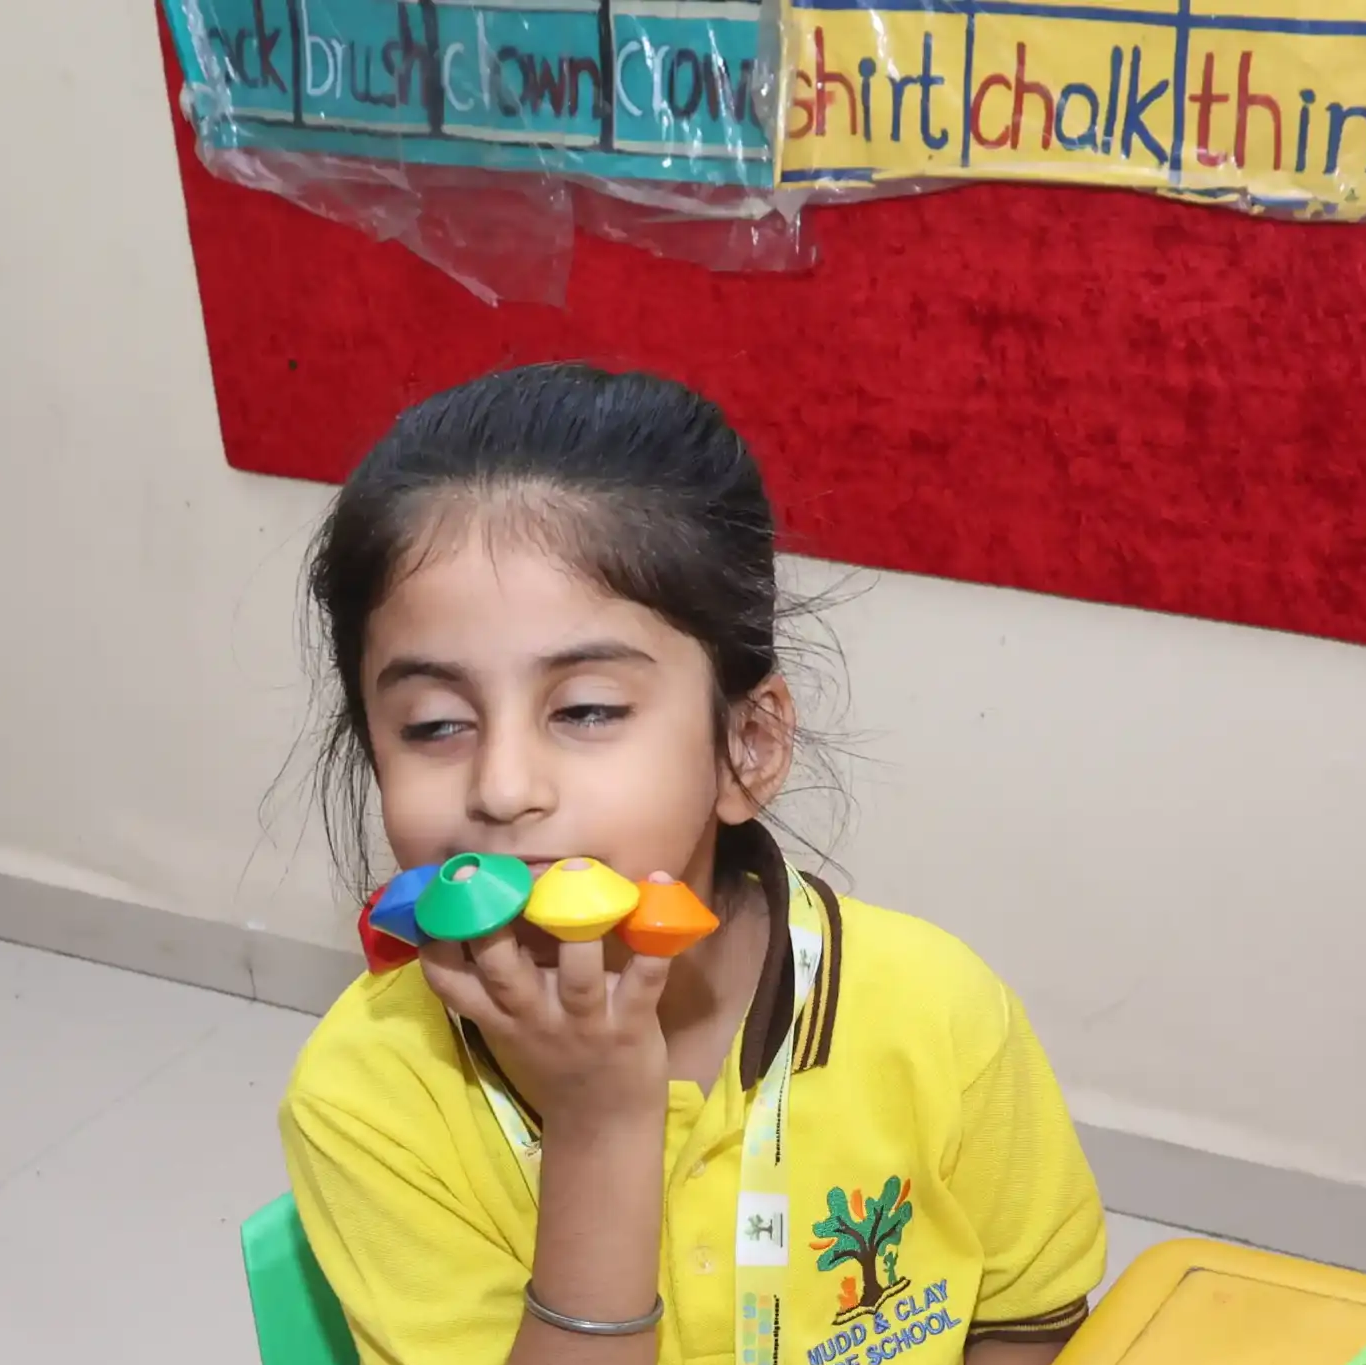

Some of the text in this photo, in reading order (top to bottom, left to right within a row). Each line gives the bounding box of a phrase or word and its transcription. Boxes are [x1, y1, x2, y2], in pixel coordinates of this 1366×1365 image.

[301, 0, 433, 108] brush
[443, 10, 605, 119] clown
[786, 26, 949, 150] shirt
[971, 41, 1169, 167] chalk
[873, 1311, 891, 1335] &
[894, 1279, 949, 1321] CLAY
